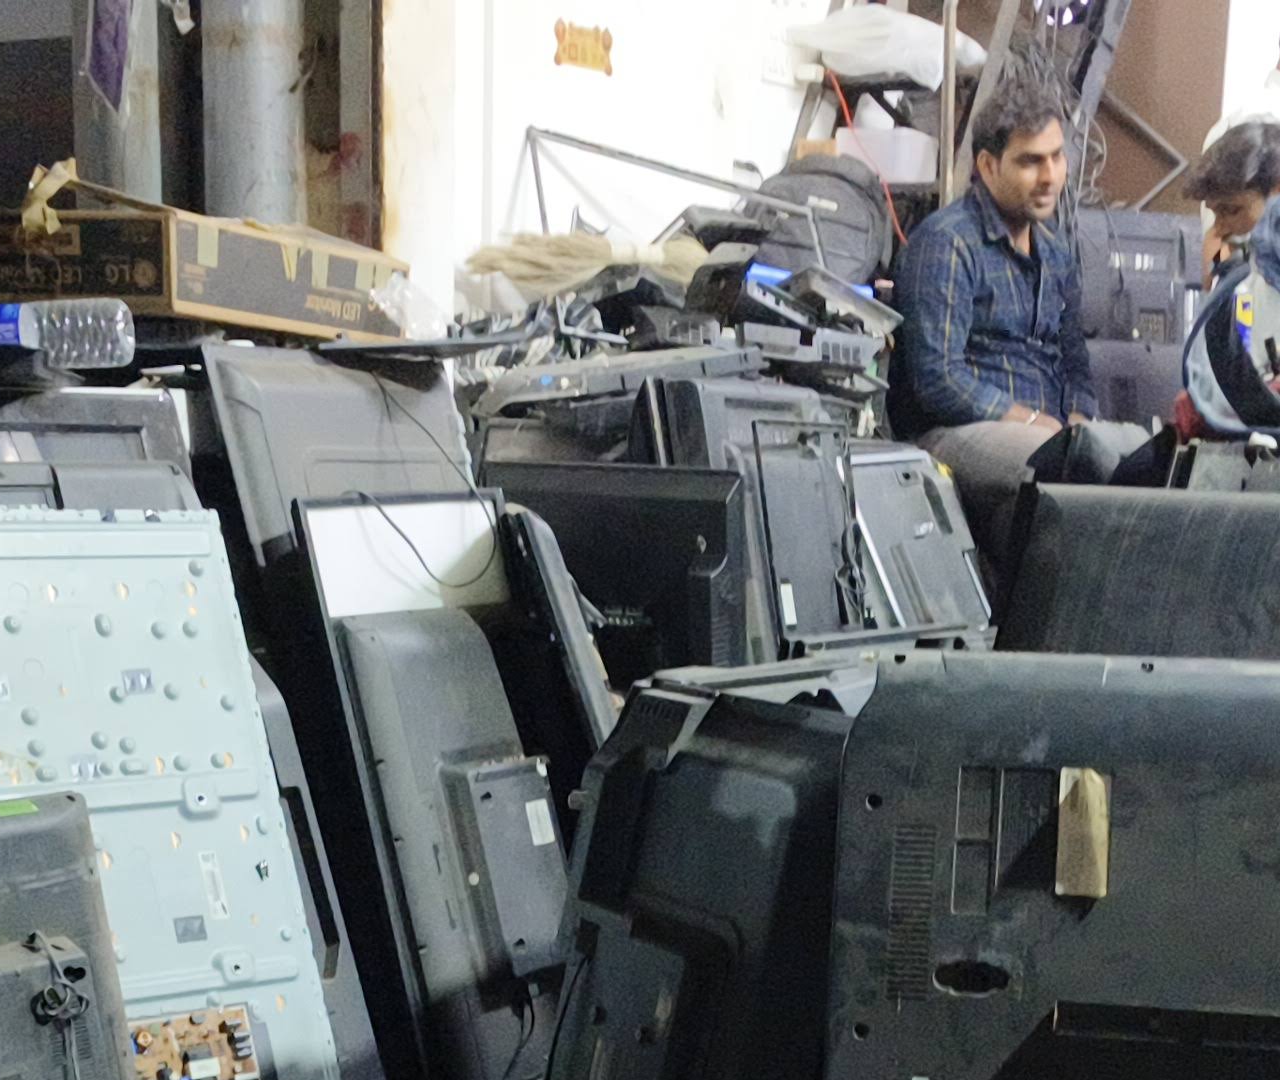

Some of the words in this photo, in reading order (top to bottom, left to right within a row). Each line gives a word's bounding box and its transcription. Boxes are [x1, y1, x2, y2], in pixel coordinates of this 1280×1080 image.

[104, 262, 131, 284] LG
[303, 293, 342, 320] Monitor
[342, 300, 362, 322] LED
